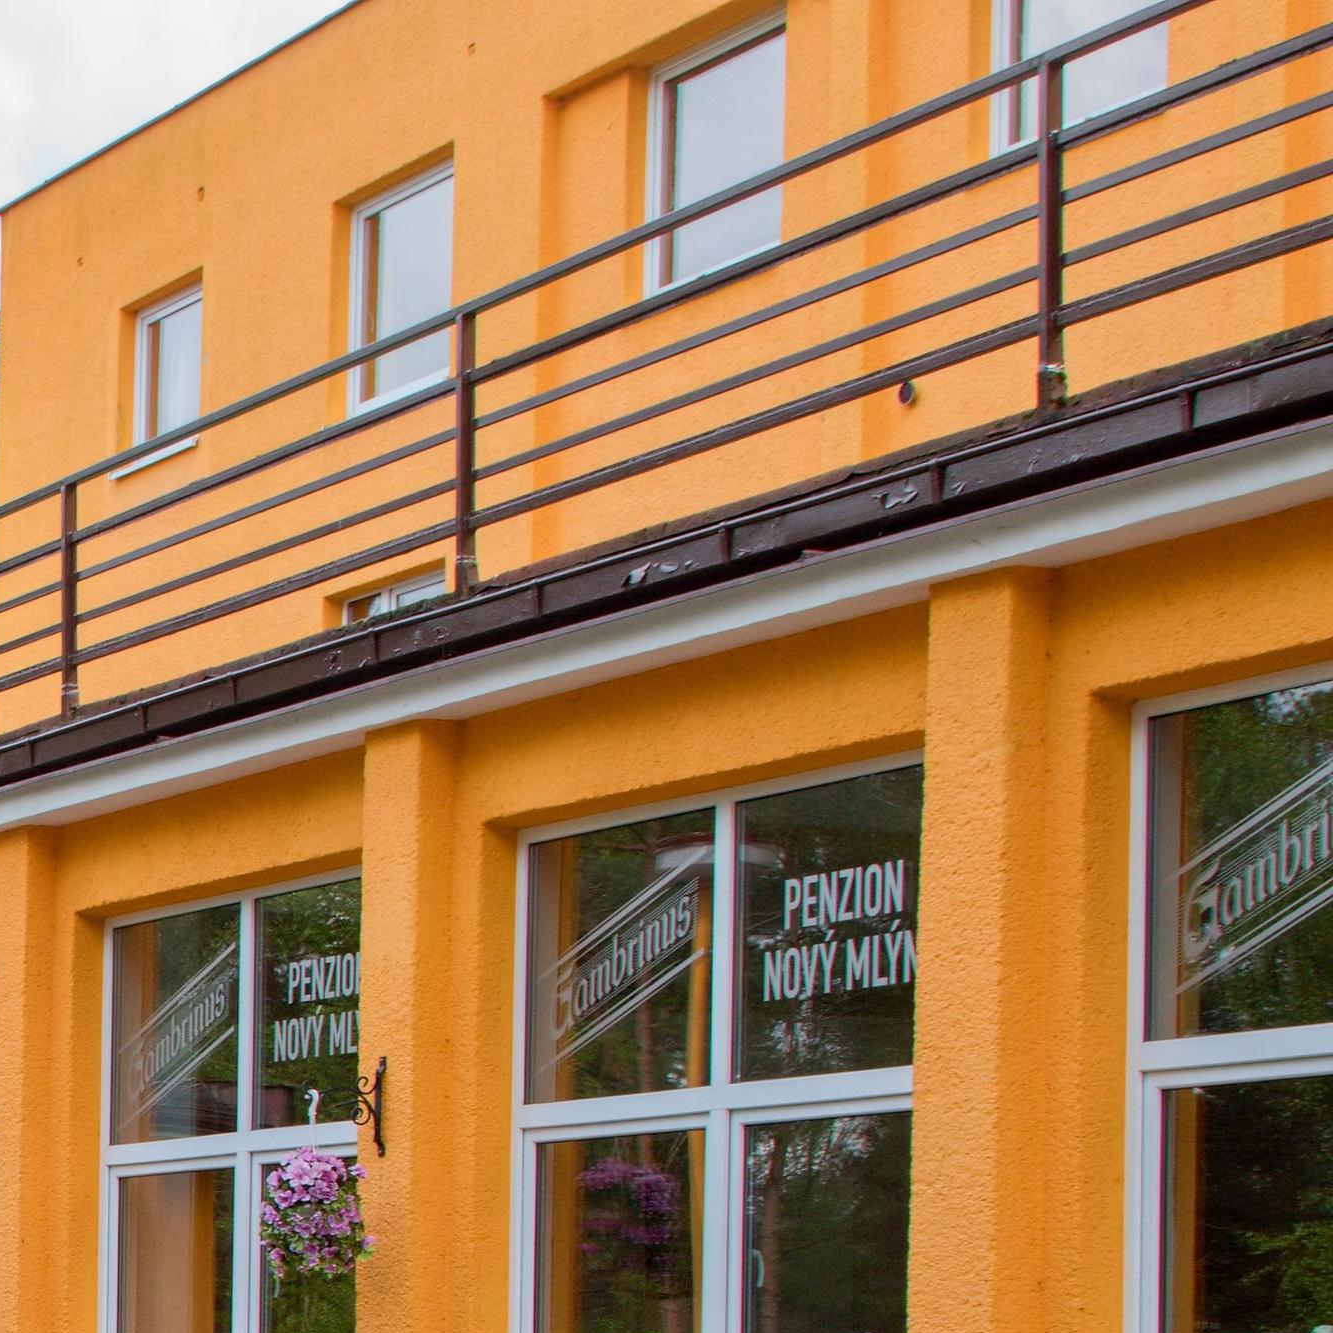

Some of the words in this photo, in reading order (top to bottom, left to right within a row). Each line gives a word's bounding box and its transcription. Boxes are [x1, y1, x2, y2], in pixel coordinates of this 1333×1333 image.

[784, 859, 905, 930] PENZION
[1185, 797, 1333, 961] Gambri
[550, 895, 693, 1040] Gambrinus
[763, 929, 838, 1002] NOVÝ
[128, 982, 226, 1100] Gambrinus
[274, 1005, 325, 1063] NOVÝ
[329, 1010, 359, 1057] ML
